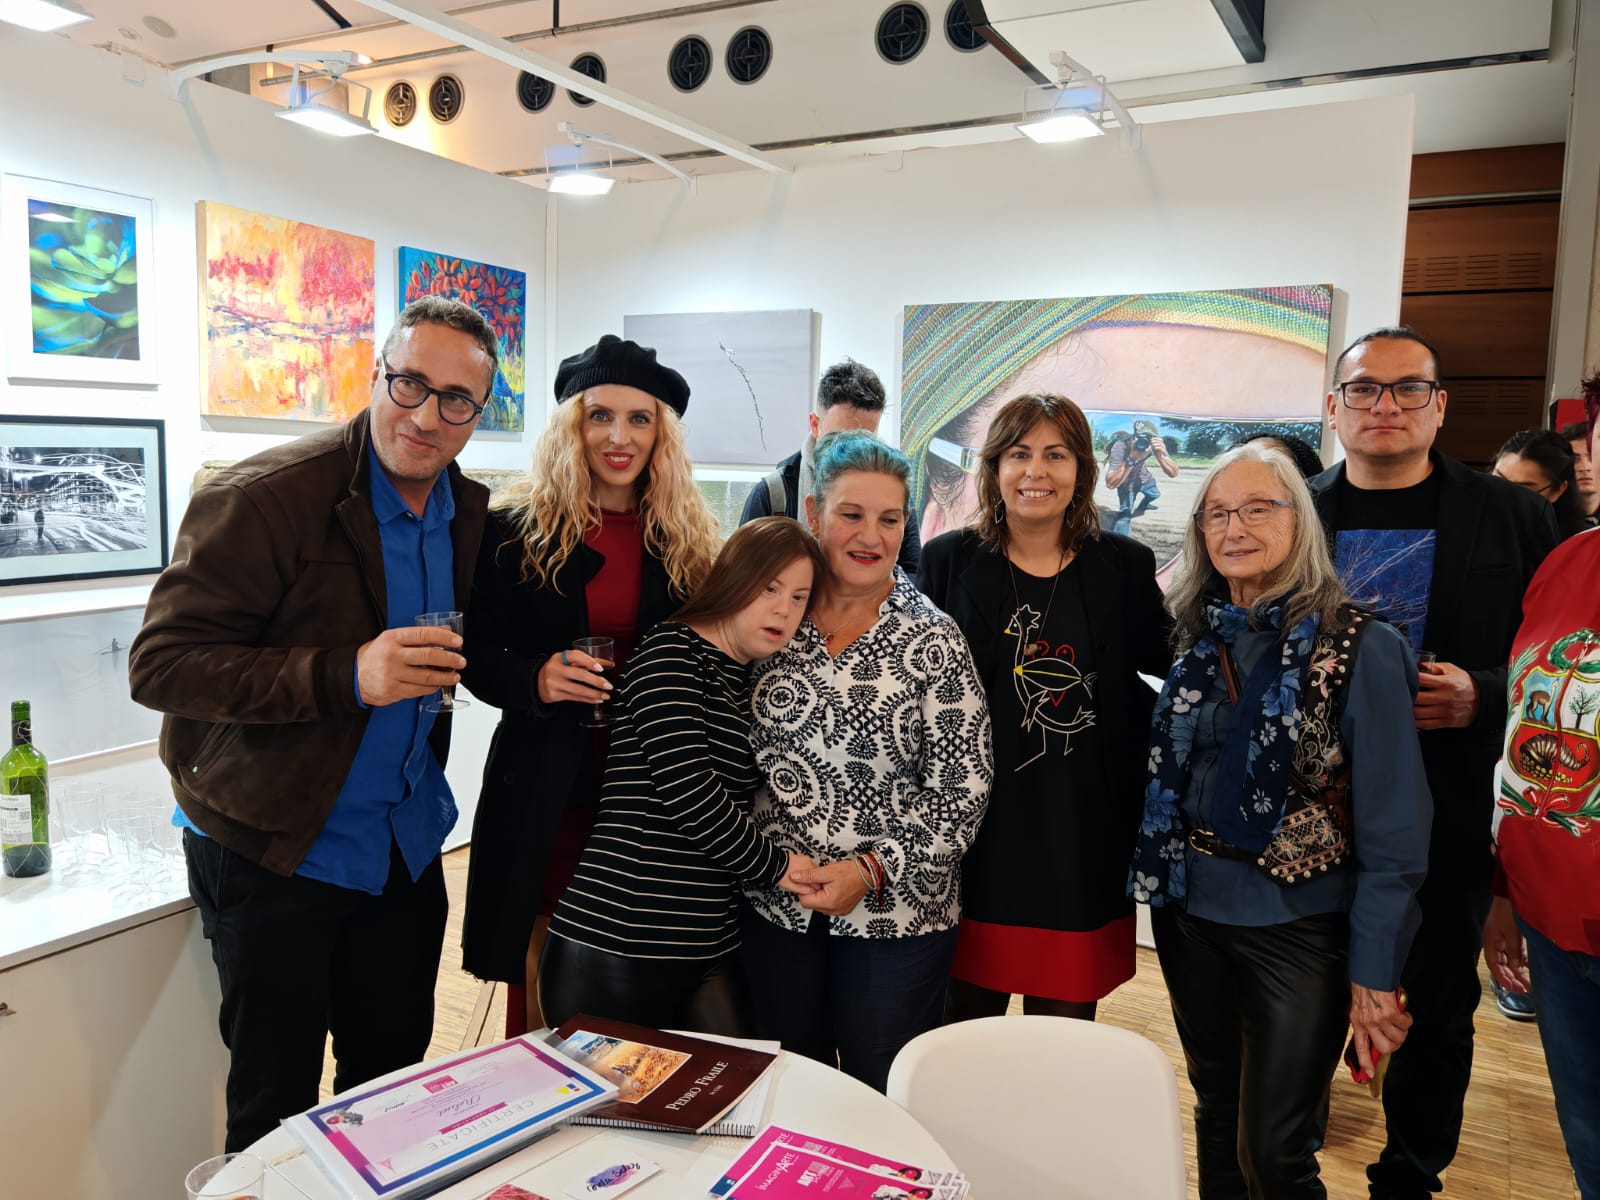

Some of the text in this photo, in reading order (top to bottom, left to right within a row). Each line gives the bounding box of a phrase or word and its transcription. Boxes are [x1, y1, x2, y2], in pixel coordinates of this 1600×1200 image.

[664, 1086, 702, 1111] PEDRO
[694, 1060, 729, 1086] FRAILE
[425, 1099, 535, 1152] CERTIFICATE
